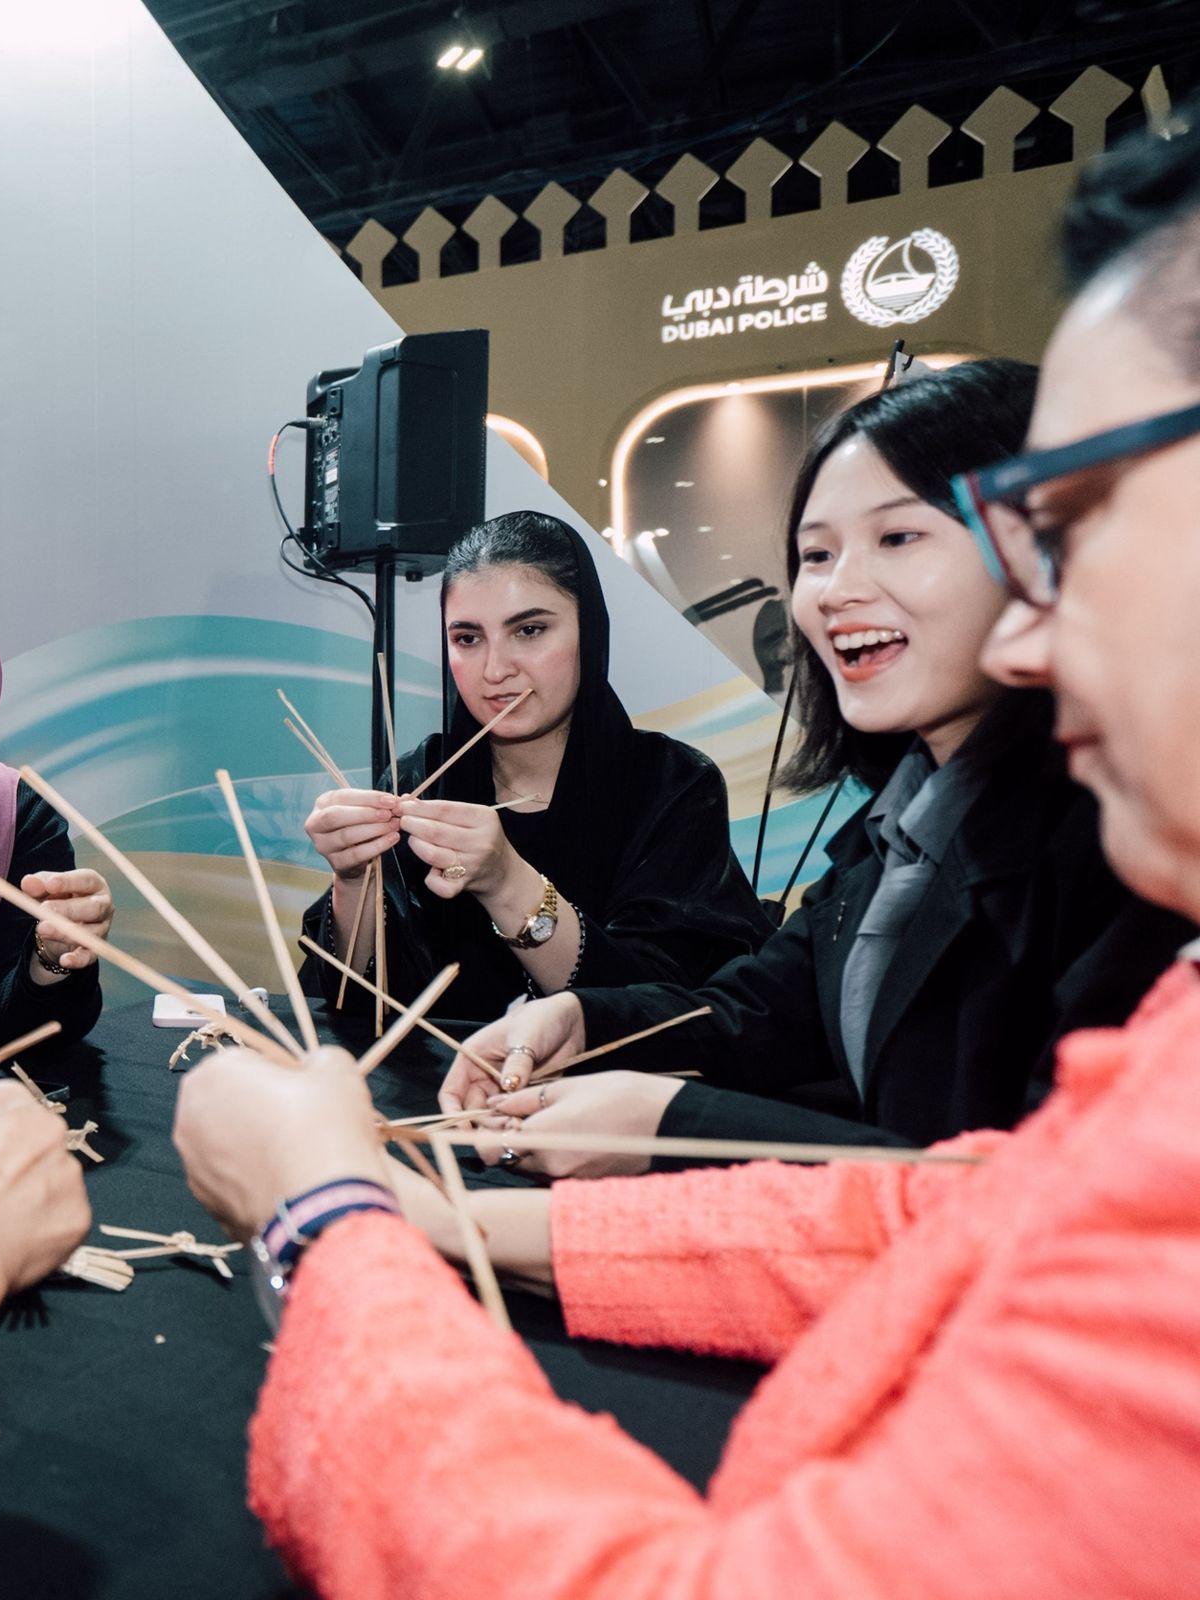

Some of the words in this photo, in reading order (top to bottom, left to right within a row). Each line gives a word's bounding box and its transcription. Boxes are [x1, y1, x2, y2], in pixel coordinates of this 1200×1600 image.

[662, 286, 731, 321] دبي
[732, 261, 828, 307] شرطة
[662, 317, 733, 343] DUBAI
[738, 302, 828, 332] POLICE
